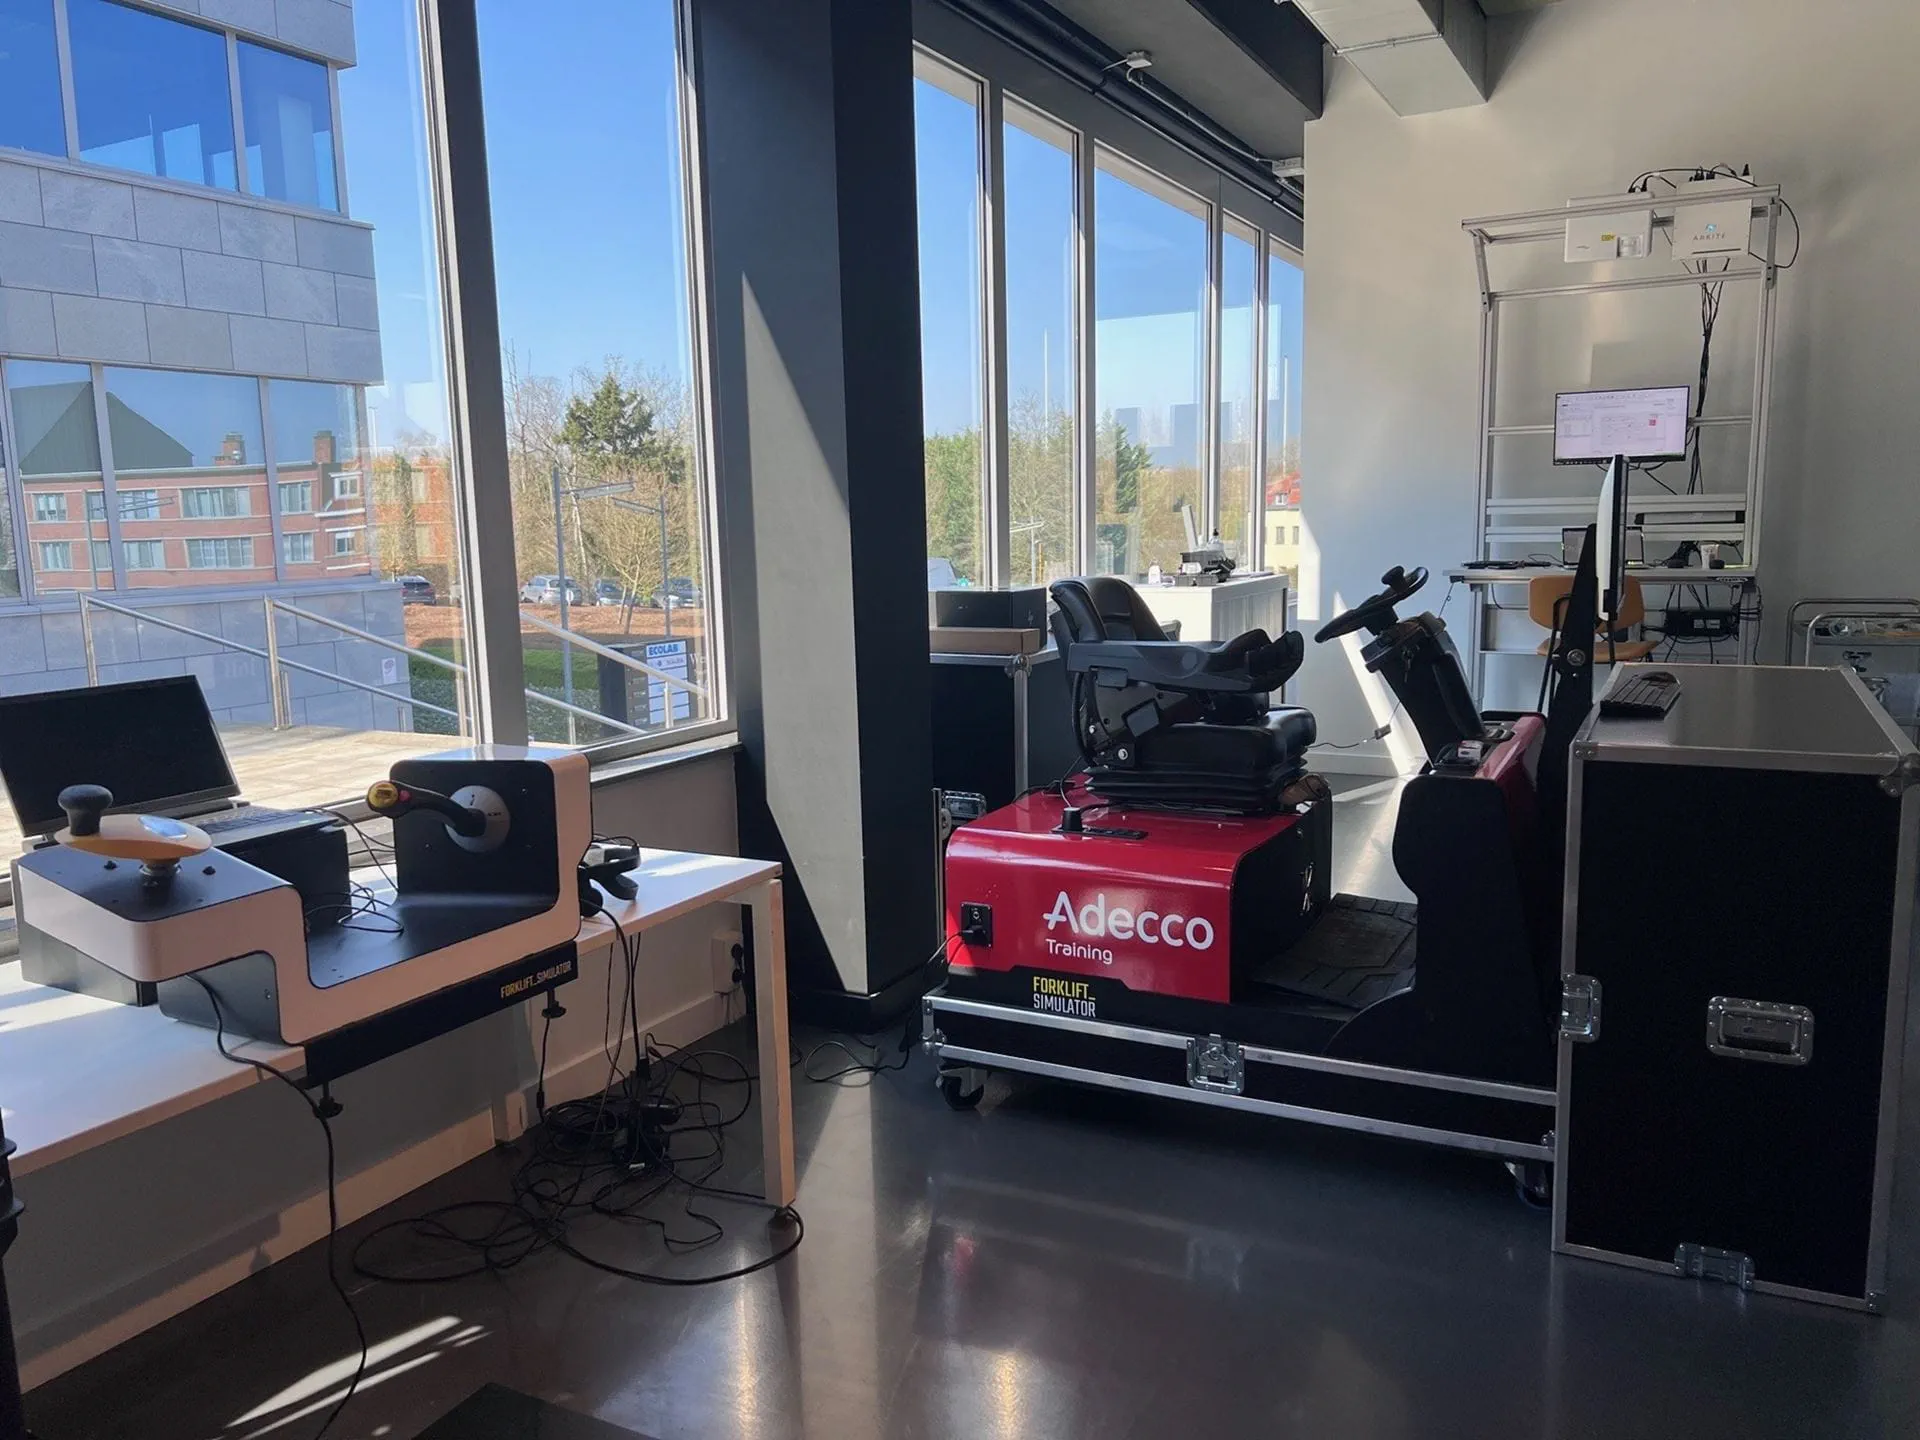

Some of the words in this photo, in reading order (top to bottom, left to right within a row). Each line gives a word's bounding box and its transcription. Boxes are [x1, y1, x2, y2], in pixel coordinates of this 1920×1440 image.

[648, 644, 679, 656] ECOLAB
[1043, 891, 1214, 950] Adecco
[1045, 938, 1113, 965] Training
[1033, 993, 1096, 1018] SIMULATOR
